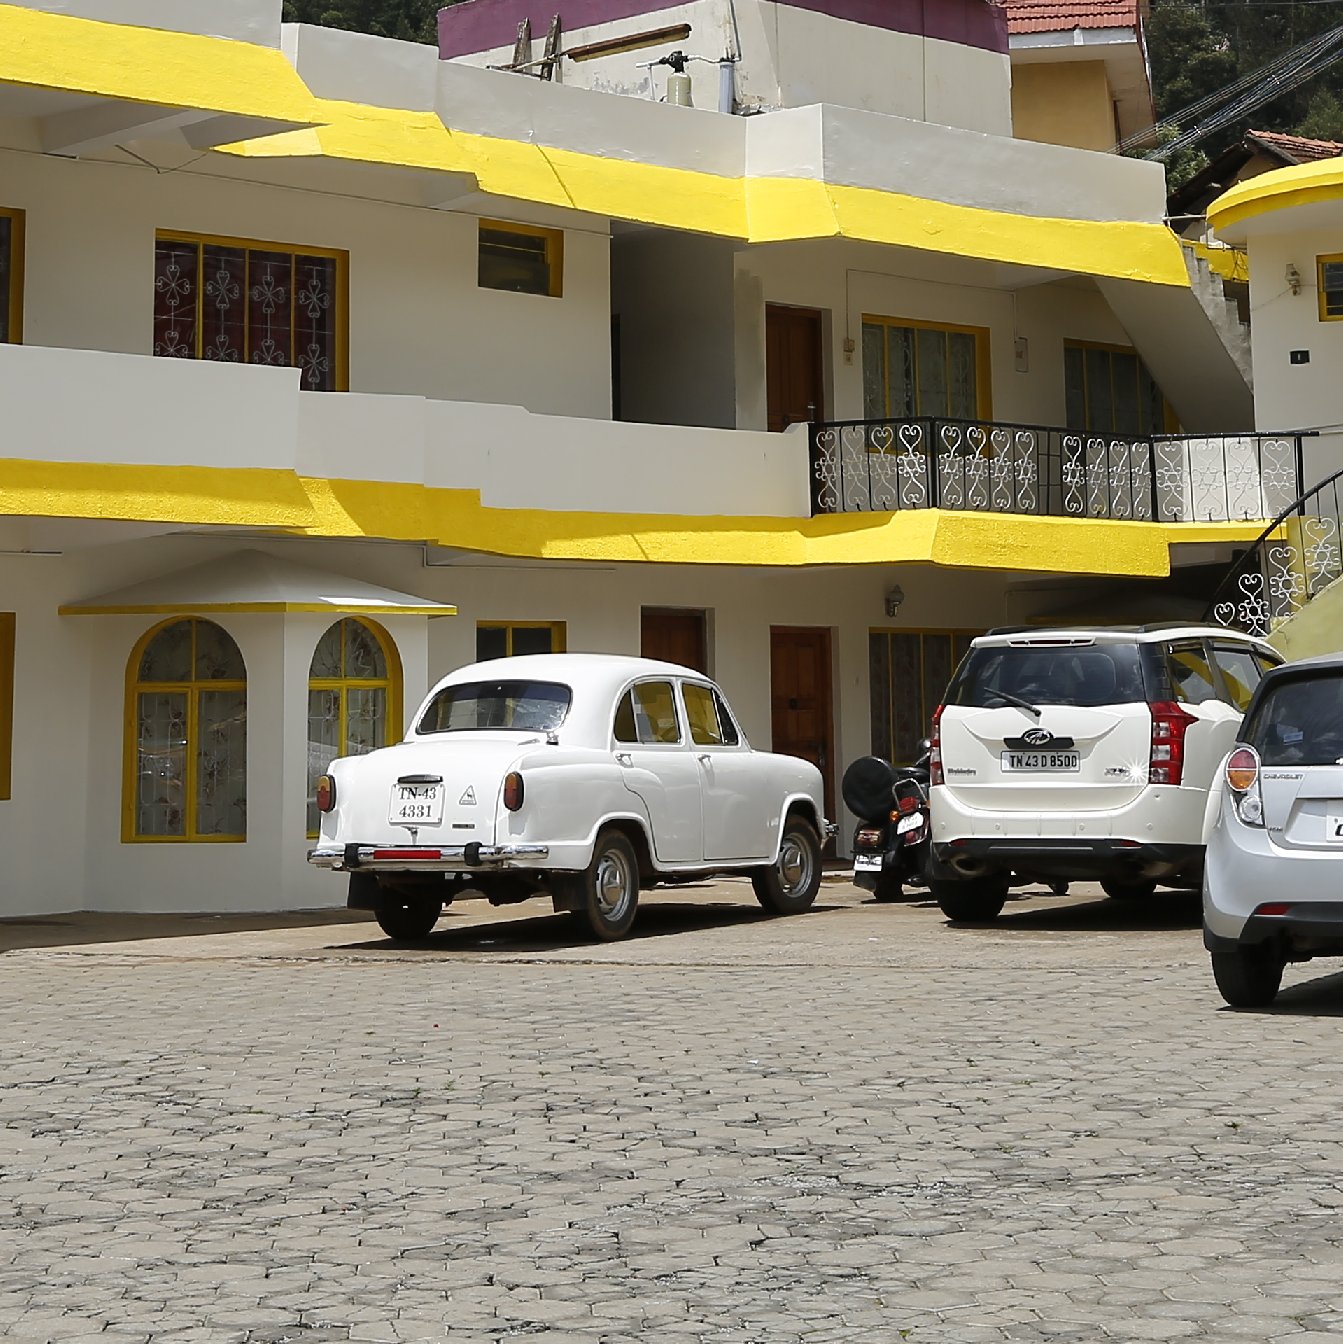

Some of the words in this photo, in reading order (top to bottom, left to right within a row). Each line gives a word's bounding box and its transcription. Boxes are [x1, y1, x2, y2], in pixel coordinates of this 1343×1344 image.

[1009, 755, 1023, 768] TN
[1024, 755, 1039, 768] 43
[1050, 755, 1077, 768] 8500
[398, 786, 437, 800] TN-43
[398, 804, 432, 818] 4331
